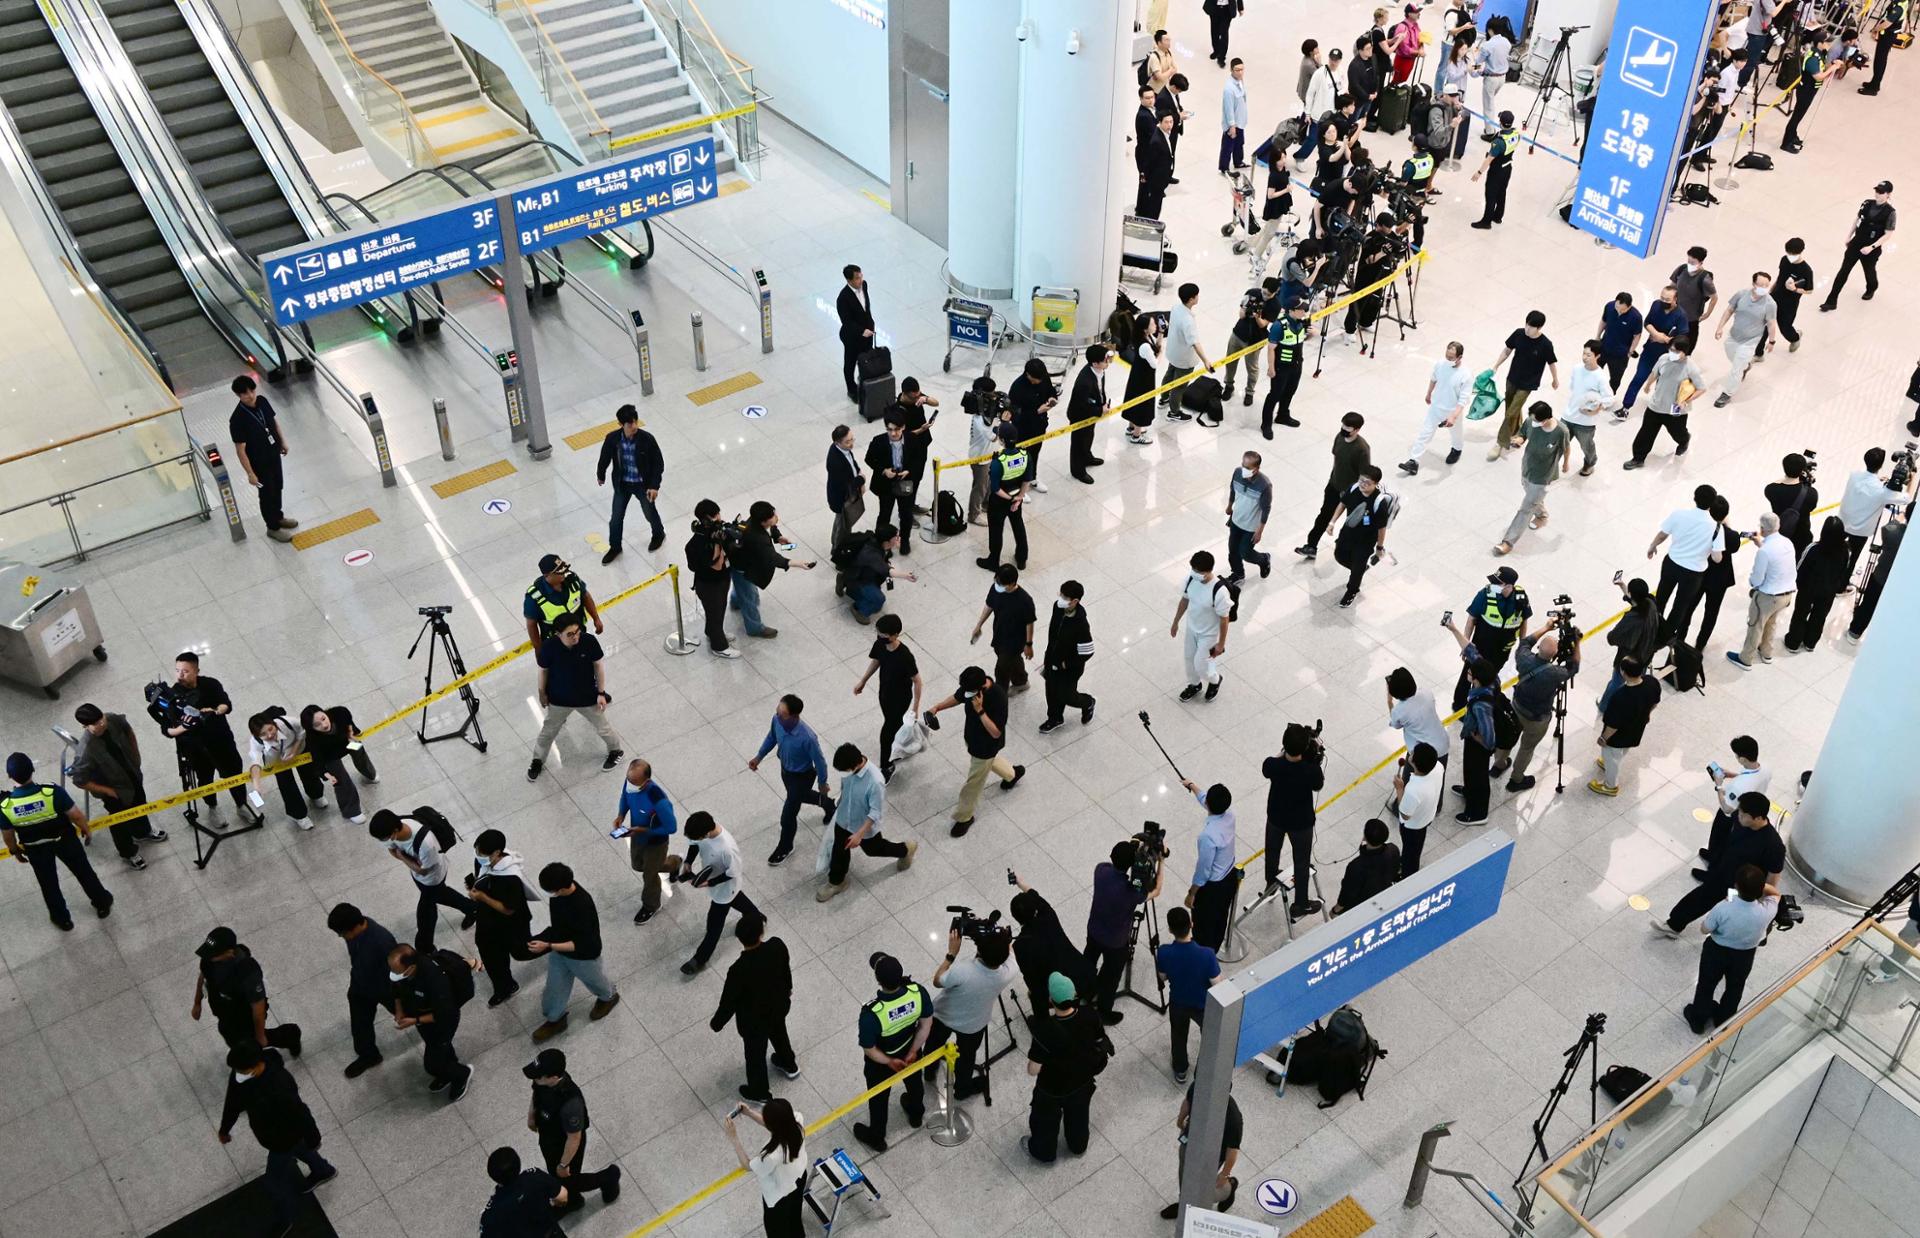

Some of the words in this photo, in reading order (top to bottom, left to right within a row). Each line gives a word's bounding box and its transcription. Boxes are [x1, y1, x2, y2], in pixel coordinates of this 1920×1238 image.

[1620, 109, 1650, 138] 1층
[1600, 128, 1654, 169] 도착층
[630, 160, 667, 182] 주차장
[595, 181, 628, 196] Parking
[1608, 176, 1631, 199] 1F
[472, 208, 494, 229] 3F
[605, 216, 617, 225] Bus
[1577, 205, 1617, 236] Arrivals
[1618, 222, 1642, 247] Hall
[521, 228, 540, 245] B1
[327, 247, 358, 270] 출발
[362, 241, 416, 262] Departures
[477, 240, 499, 260] 2F
[429, 264, 449, 276] Public
[303, 270, 397, 310] 정부종합행정센터
[956, 324, 982, 338] NOL
[1308, 946, 1348, 973] 여기는
[1353, 928, 1376, 951] 1층
[1379, 881, 1457, 937] 도착층입니다
[1307, 972, 1323, 986] You
[1324, 967, 1338, 979] are
[1339, 960, 1349, 972] in
[1349, 951, 1364, 963] the
[1364, 932, 1395, 954] Arrivals
[1396, 920, 1413, 937] Hall
[1413, 912, 1428, 929] (1st
[1428, 898, 1452, 917] Floor)
